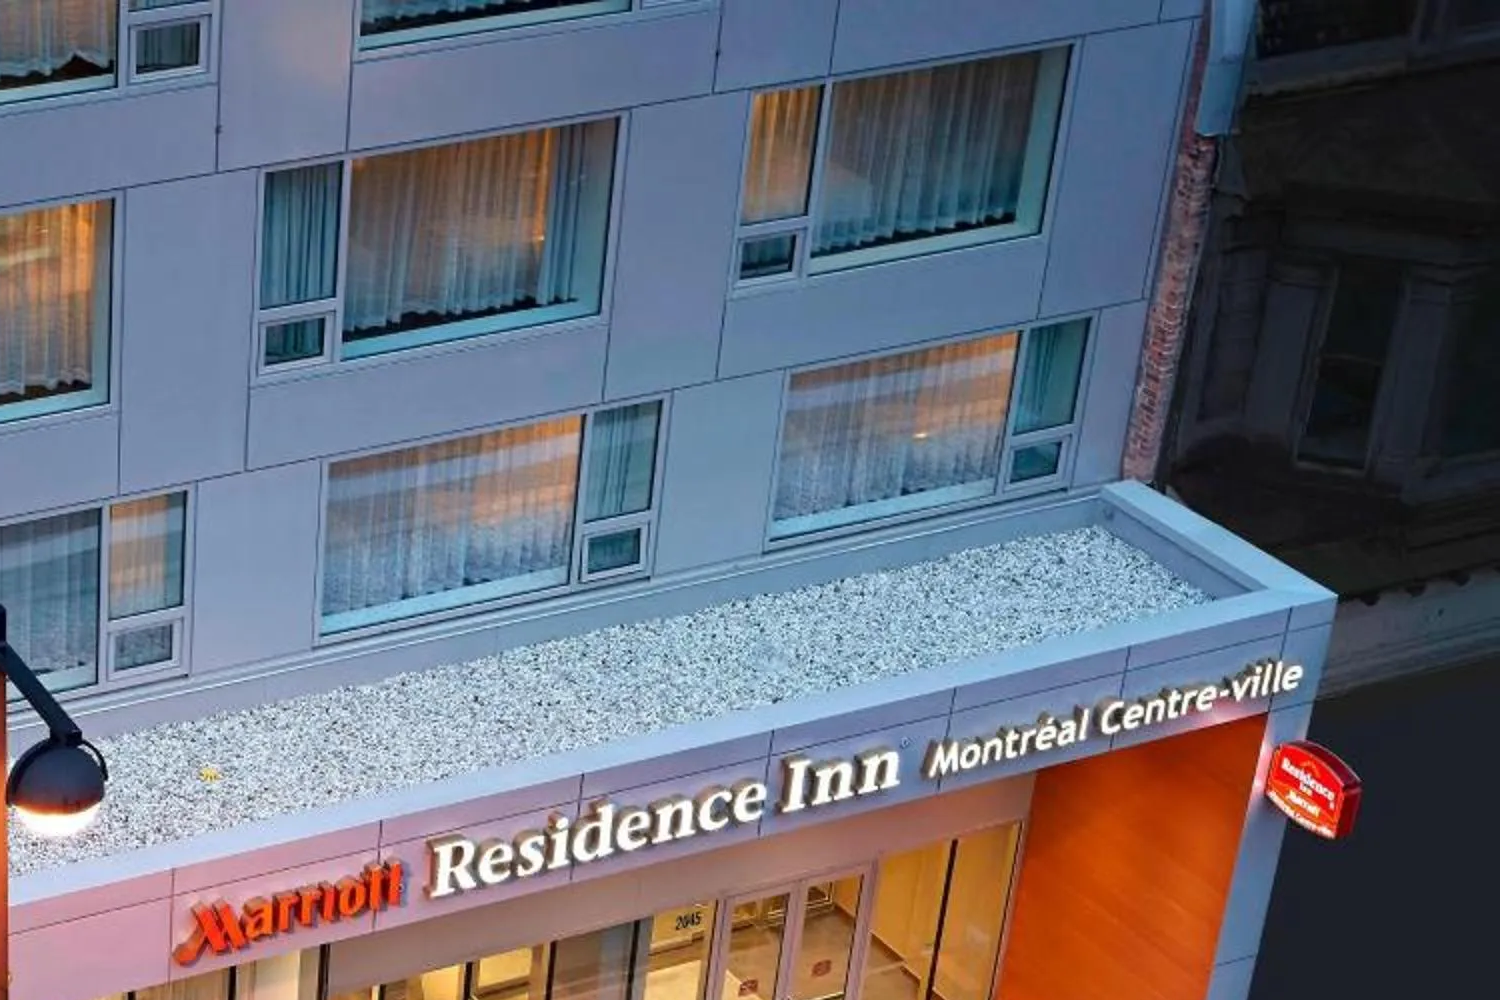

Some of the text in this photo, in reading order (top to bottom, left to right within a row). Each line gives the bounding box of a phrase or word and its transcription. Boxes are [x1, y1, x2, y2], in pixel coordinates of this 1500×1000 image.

[172, 660, 1304, 966] Marriott Residence Inn Montréal Centre-ville
